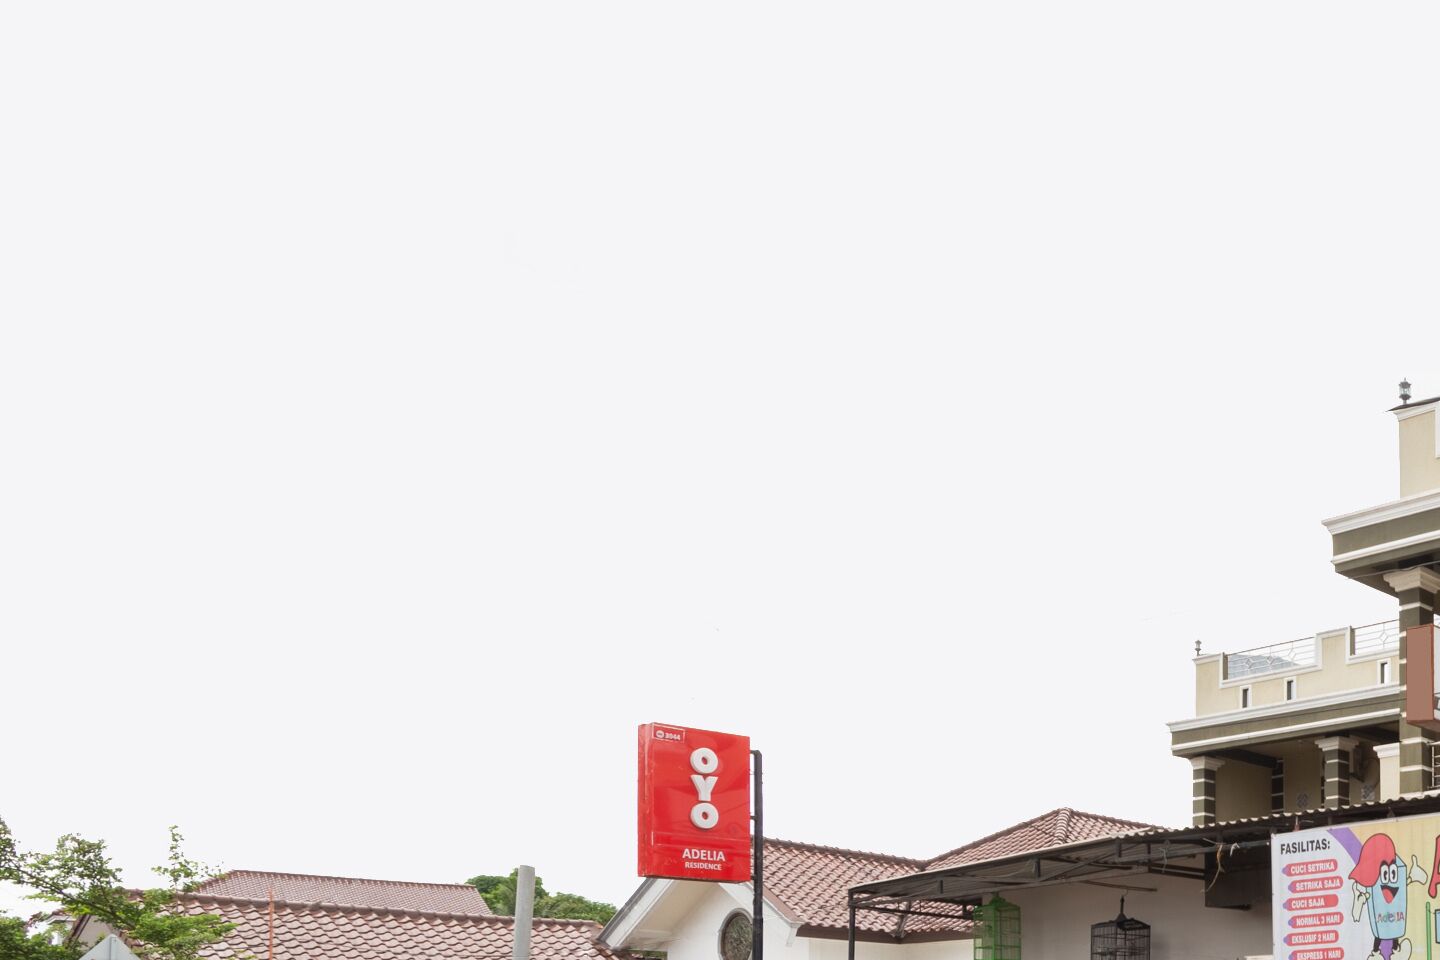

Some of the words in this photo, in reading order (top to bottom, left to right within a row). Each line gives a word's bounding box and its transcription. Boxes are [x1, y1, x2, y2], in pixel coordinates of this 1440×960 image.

[690, 746, 720, 830] OYO
[1280, 838, 1330, 855] FASILITAS:
[682, 848, 726, 862] ADELIA
[684, 860, 722, 872] RESIDENCE
[1290, 864, 1306, 874] CUCI
[1307, 861, 1334, 873] SETRIKA
[1296, 880, 1323, 891] SETRIKA
[1324, 878, 1340, 888] SAJA
[1291, 899, 1307, 909] CUCI
[1308, 898, 1325, 907] SAJA
[1296, 916, 1320, 926] NORMAL
[1326, 914, 1340, 923] HARI
[1318, 934, 1321, 942] 2
[1322, 933, 1336, 942] HARI
[1296, 952, 1323, 960] EKSPRESS
[1328, 950, 1341, 959] HARI
